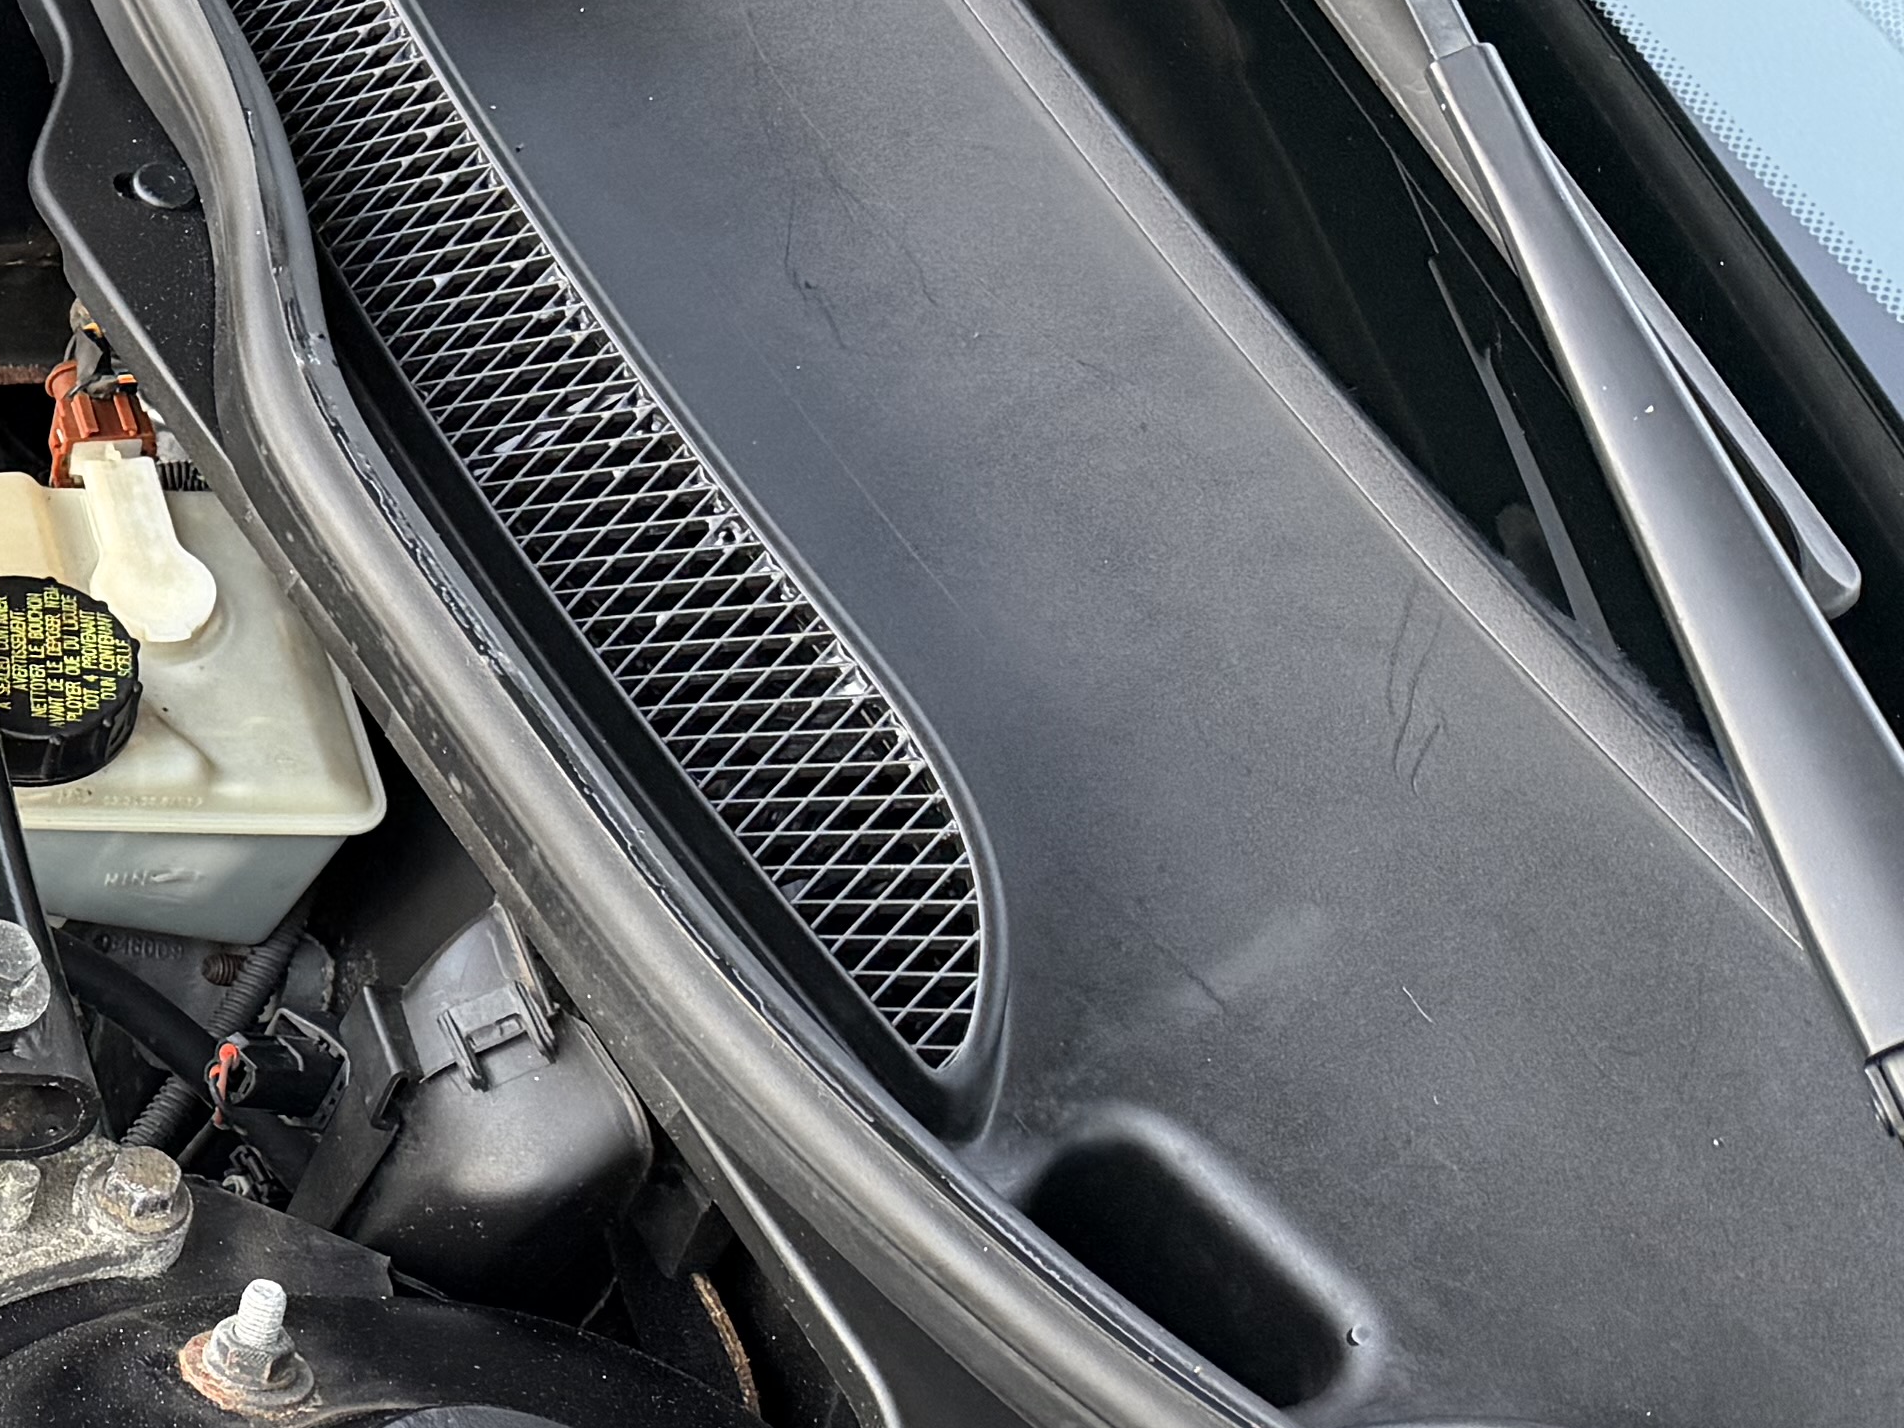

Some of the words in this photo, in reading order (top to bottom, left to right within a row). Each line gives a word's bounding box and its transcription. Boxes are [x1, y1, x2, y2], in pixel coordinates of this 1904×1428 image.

[27, 593, 43, 639] BOUCHON
[61, 595, 78, 630] LIQUIDE
[29, 646, 44, 658] LE
[64, 636, 79, 650] DU
[79, 610, 97, 669] PROVENANT
[97, 612, 115, 671] CONTENANT
[47, 660, 63, 672] LE
[65, 656, 80, 675] QUE
[30, 664, 47, 717] NETTOYER
[49, 678, 63, 690] DE
[49, 696, 65, 726] AVANT
[67, 681, 82, 721] PLOYER
[83, 689, 100, 710] DOT
